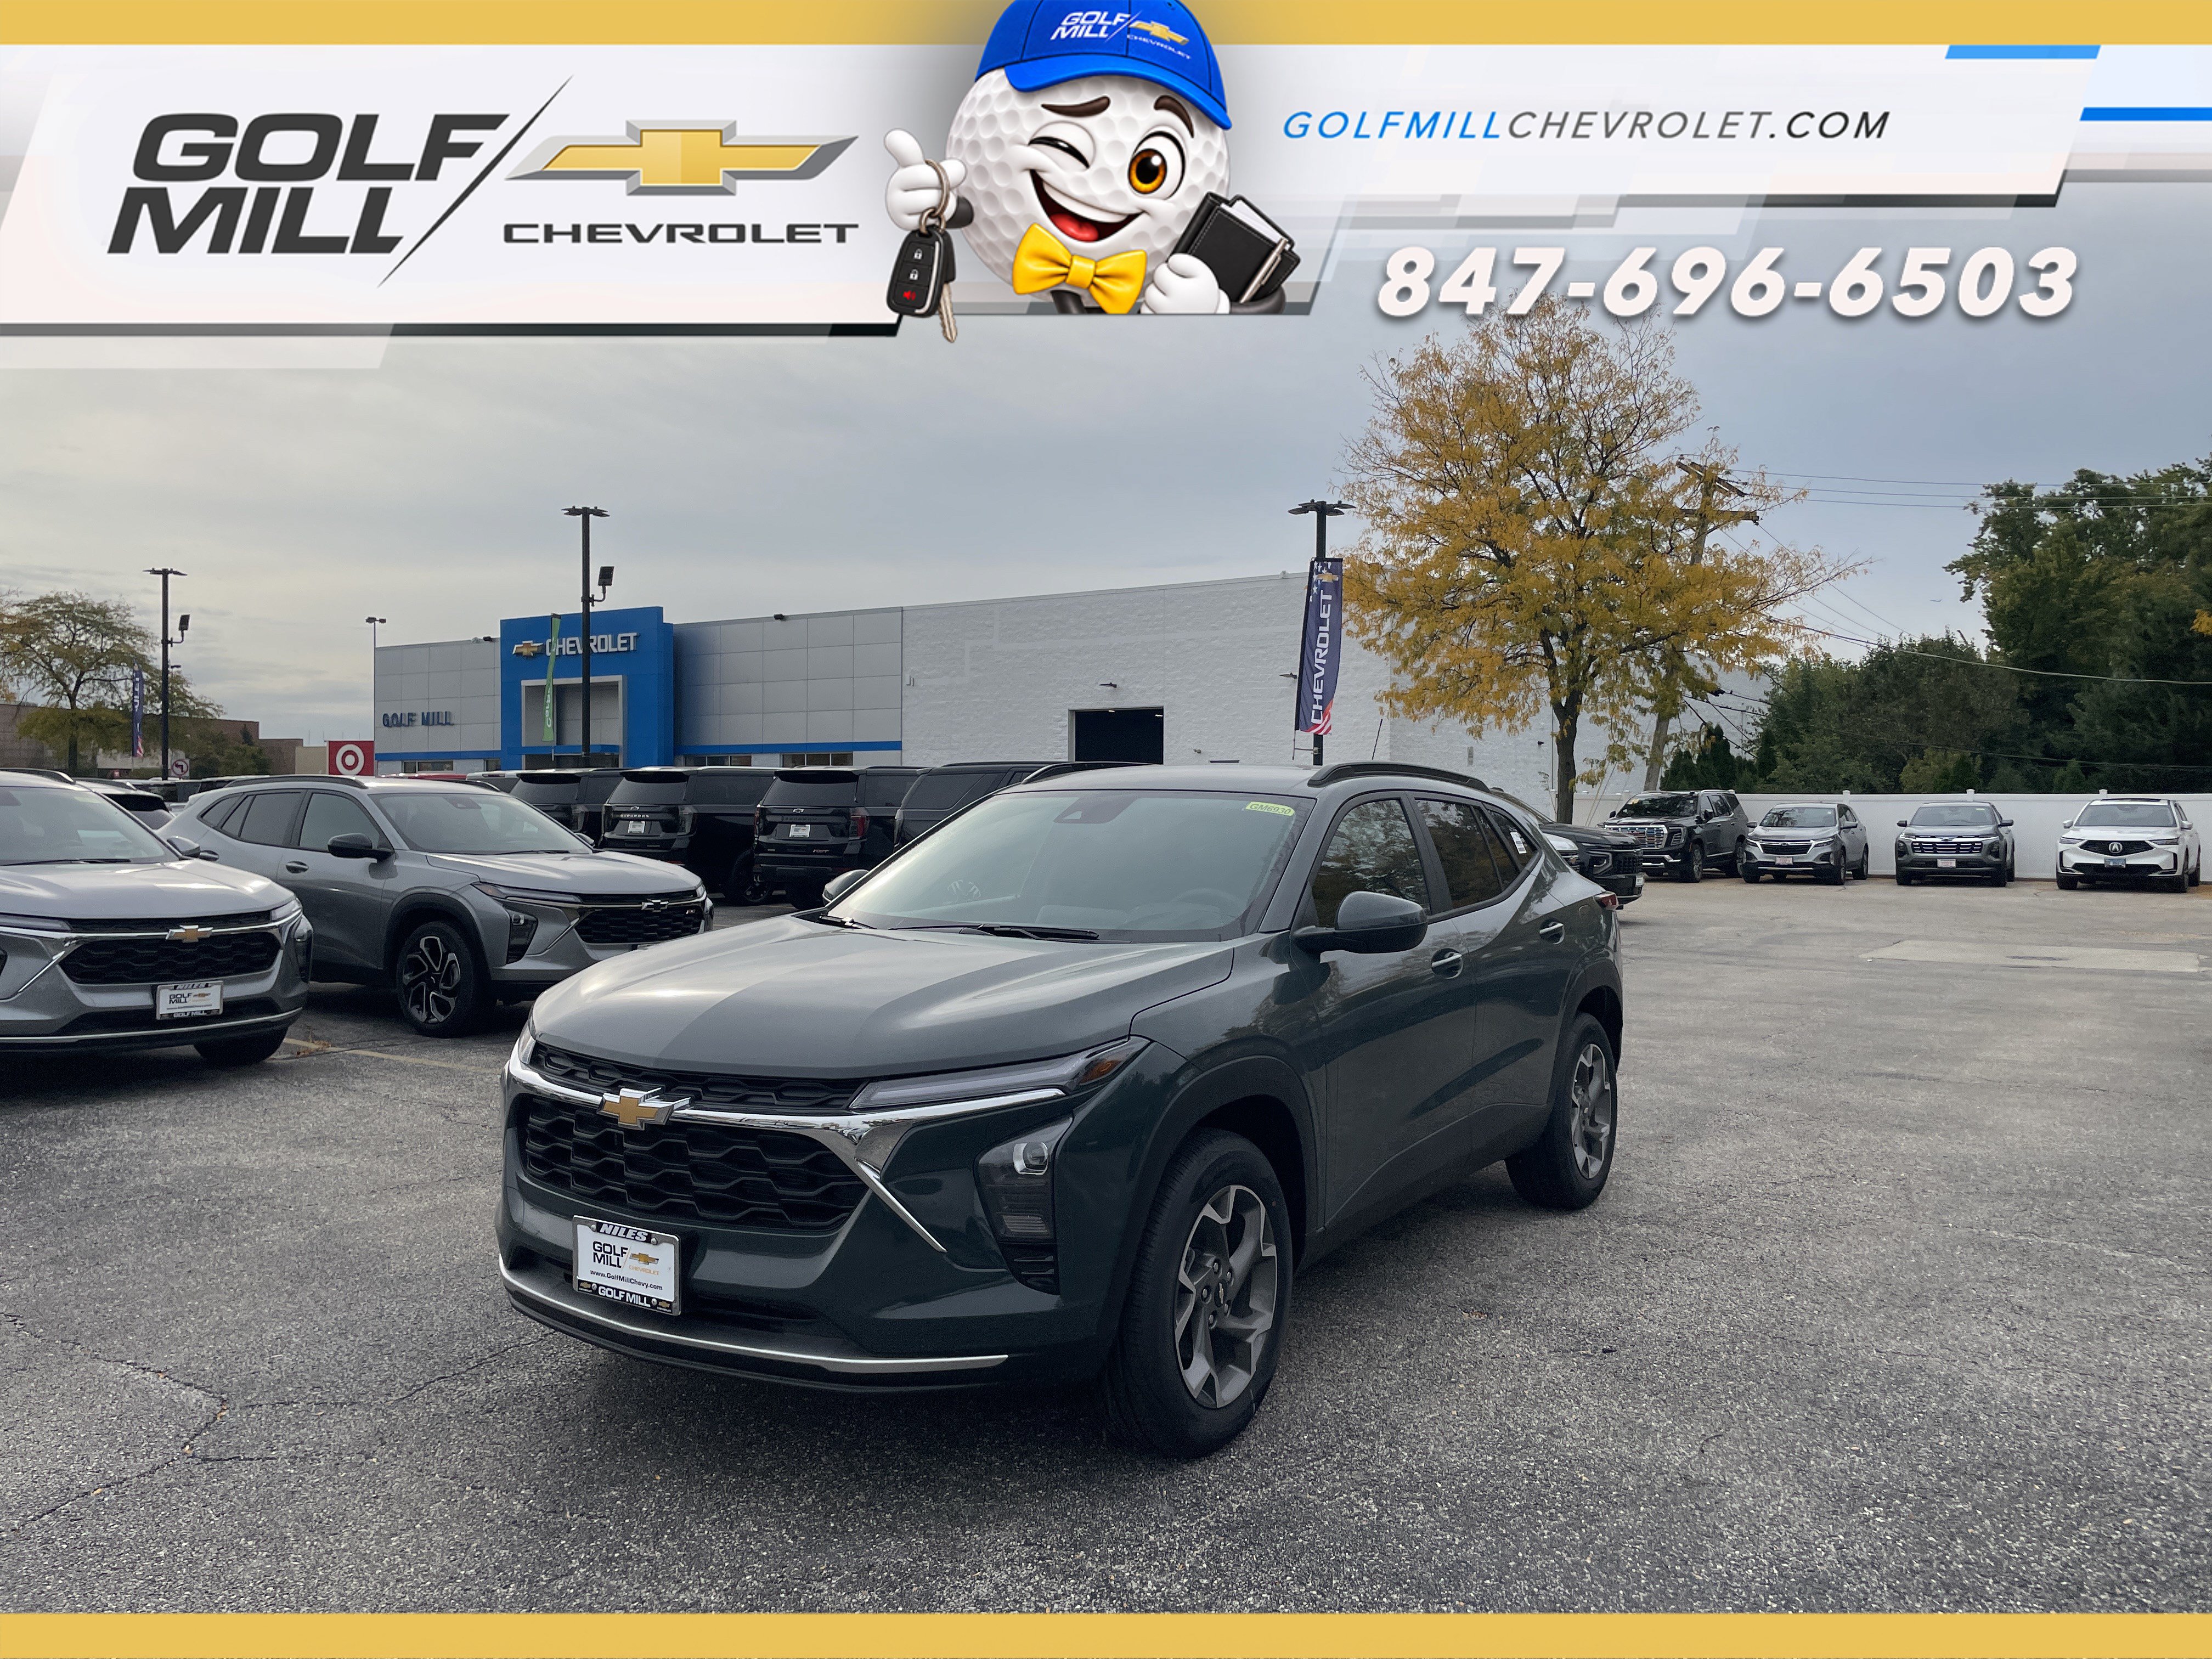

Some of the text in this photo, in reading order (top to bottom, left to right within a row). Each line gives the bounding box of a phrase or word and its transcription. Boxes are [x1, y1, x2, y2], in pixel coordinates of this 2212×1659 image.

[1311, 589, 1333, 725] CHEVROLET
[382, 711, 454, 727] GOLF MILL
[1249, 803, 1291, 815] GM6930
[600, 1223, 648, 1242] NILES
[592, 1241, 628, 1257] GOLF
[592, 1252, 622, 1268] MILL
[629, 1265, 659, 1276] CHEVROLET
[590, 1269, 663, 1291] www.GolfMillChevy.com
[598, 1286, 651, 1307] GOLF MILL
